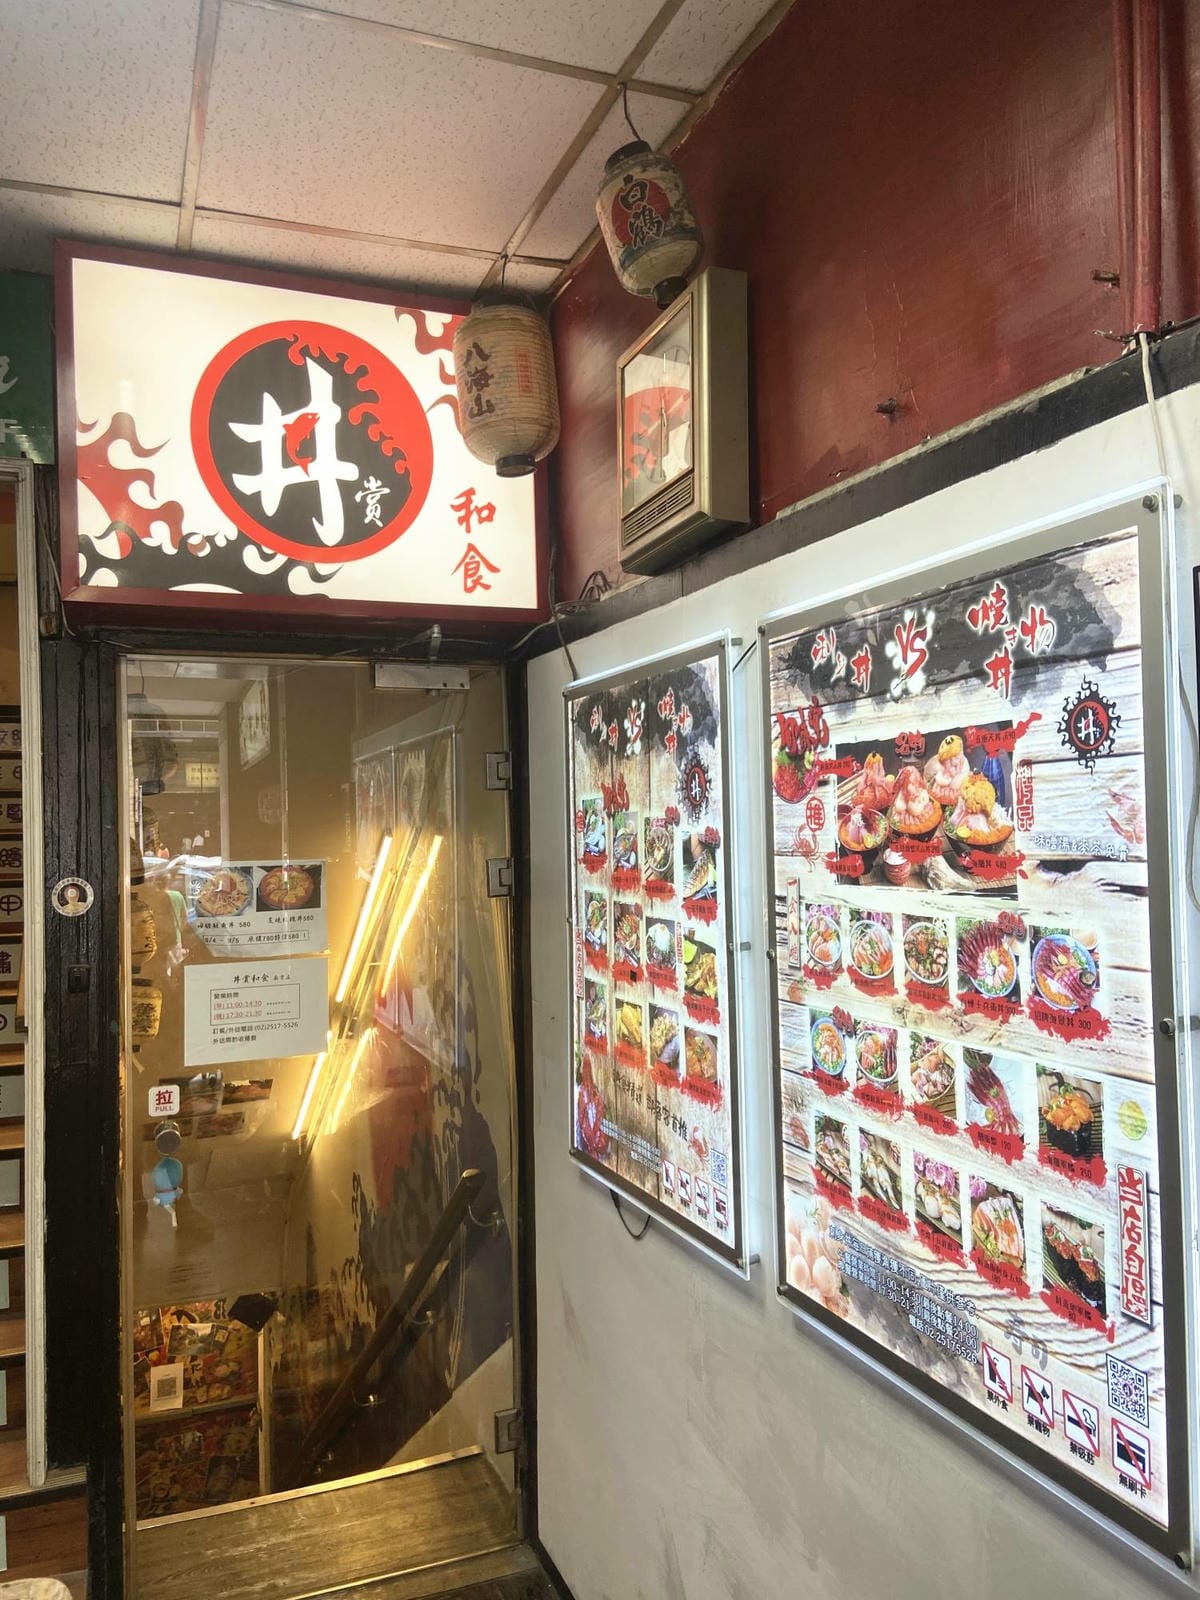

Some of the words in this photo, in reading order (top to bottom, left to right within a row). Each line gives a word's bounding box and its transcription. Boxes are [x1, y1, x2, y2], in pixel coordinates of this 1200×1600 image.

[464, 342, 496, 420] 八海山
[450, 487, 501, 595] 和食
[894, 610, 928, 690] VS
[1078, 1020, 1092, 1031] 300
[154, 1105, 174, 1113] PULL
[155, 1089, 174, 1106] 拉
[1118, 1473, 1147, 1499] 無刷卡
